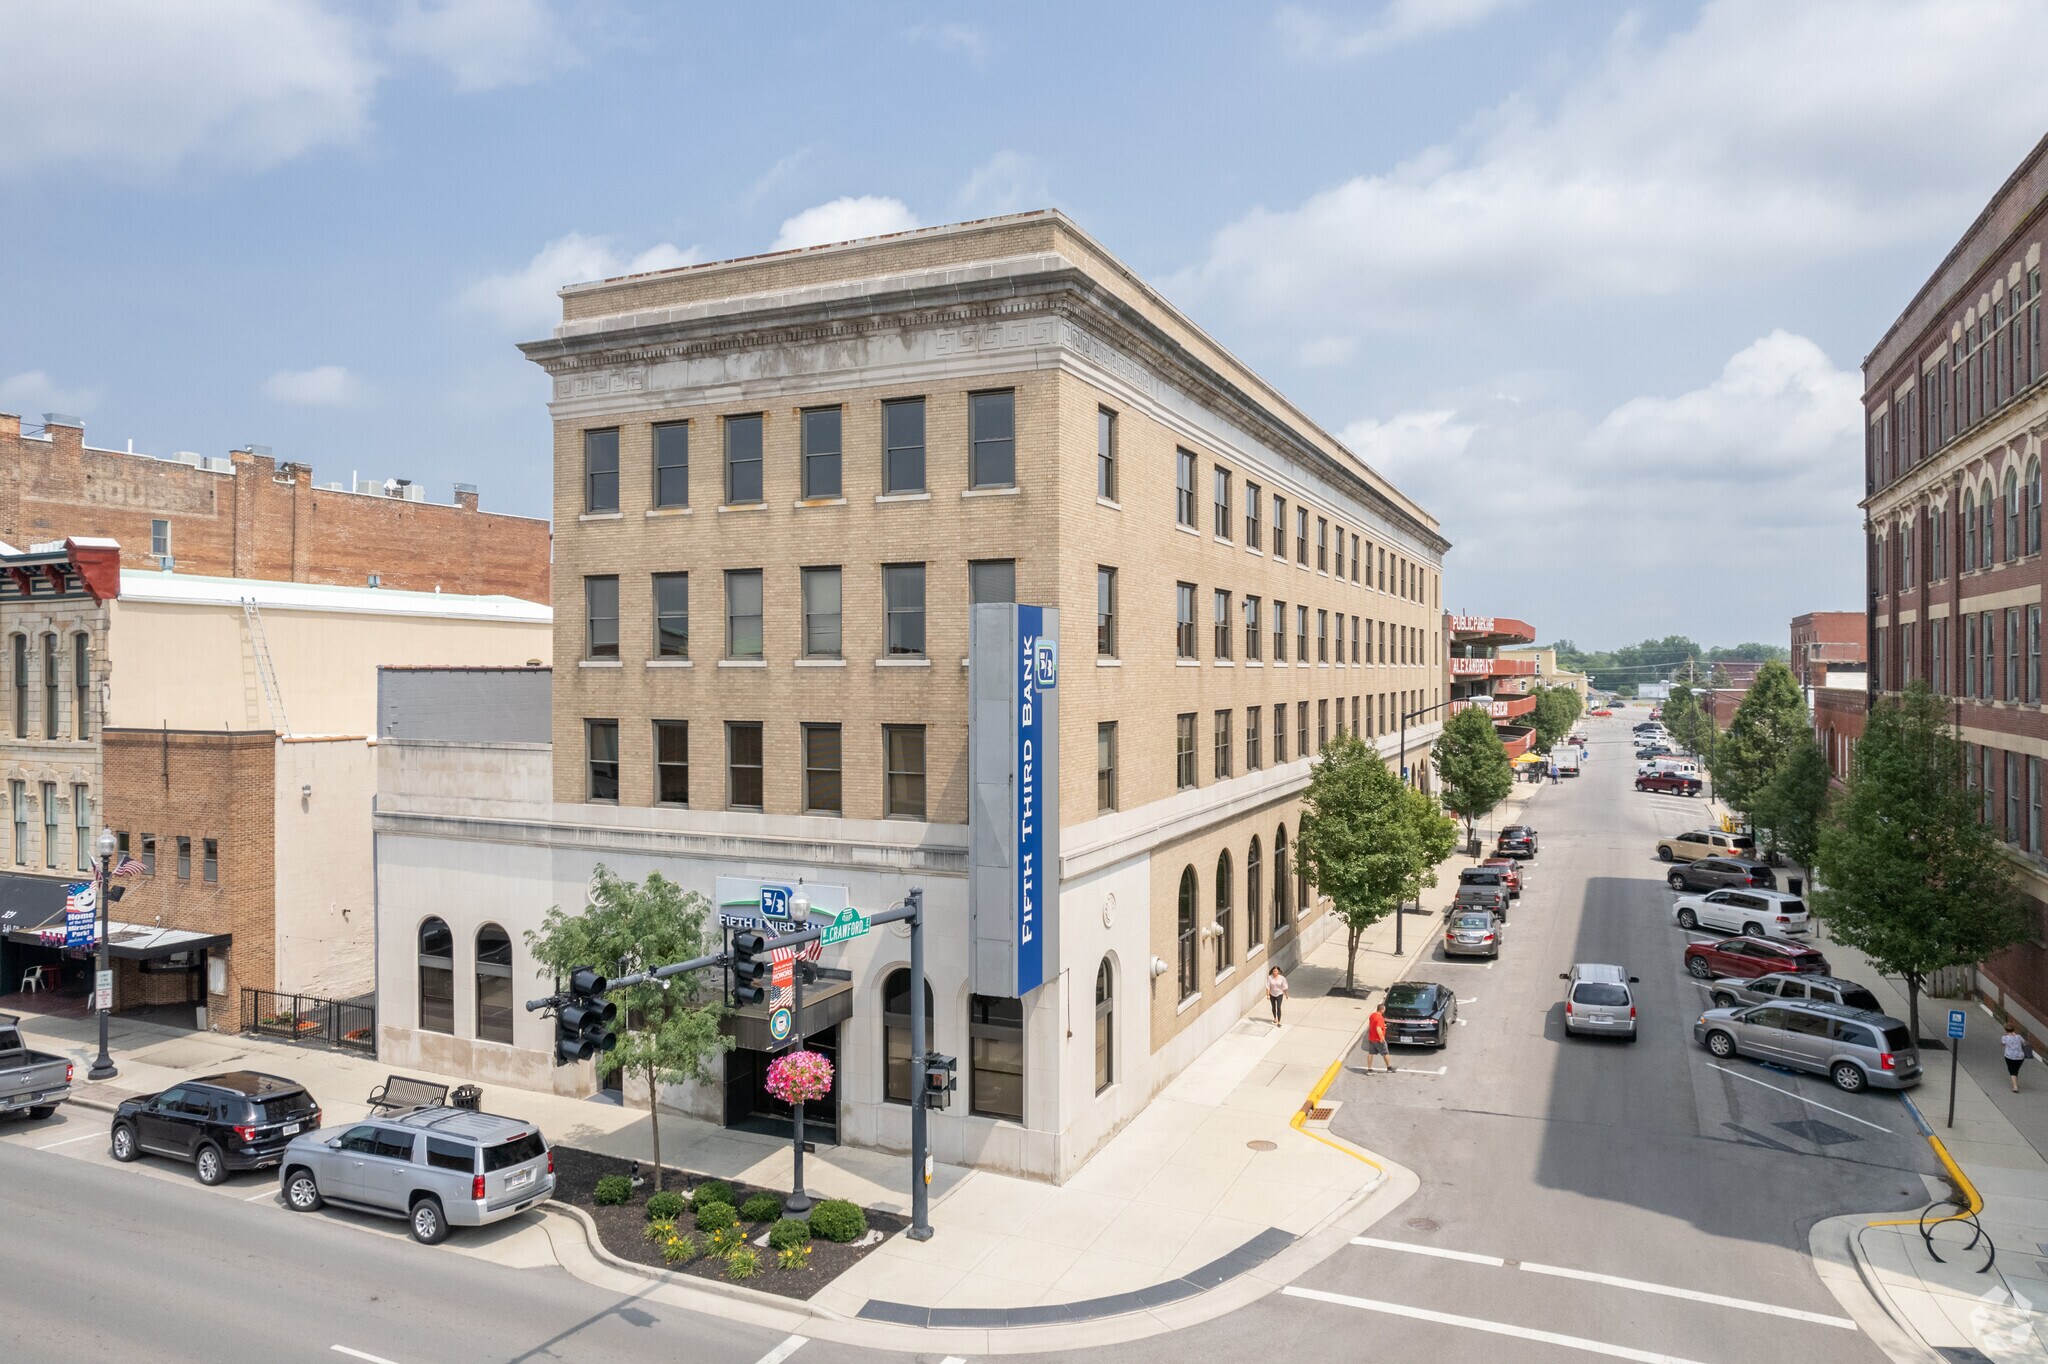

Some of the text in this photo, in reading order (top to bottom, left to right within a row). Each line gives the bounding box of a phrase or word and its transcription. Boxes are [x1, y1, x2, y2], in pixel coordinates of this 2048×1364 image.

[1453, 616, 1494, 631] PUBLIC PARKING
[1453, 658, 1494, 673] ALEXANDRIA'S
[1022, 634, 1033, 945] FIFTH THIRD BANK
[68, 912, 94, 920] Home
[718, 914, 753, 928] FIFTH
[829, 920, 864, 942] CRAWFORD
